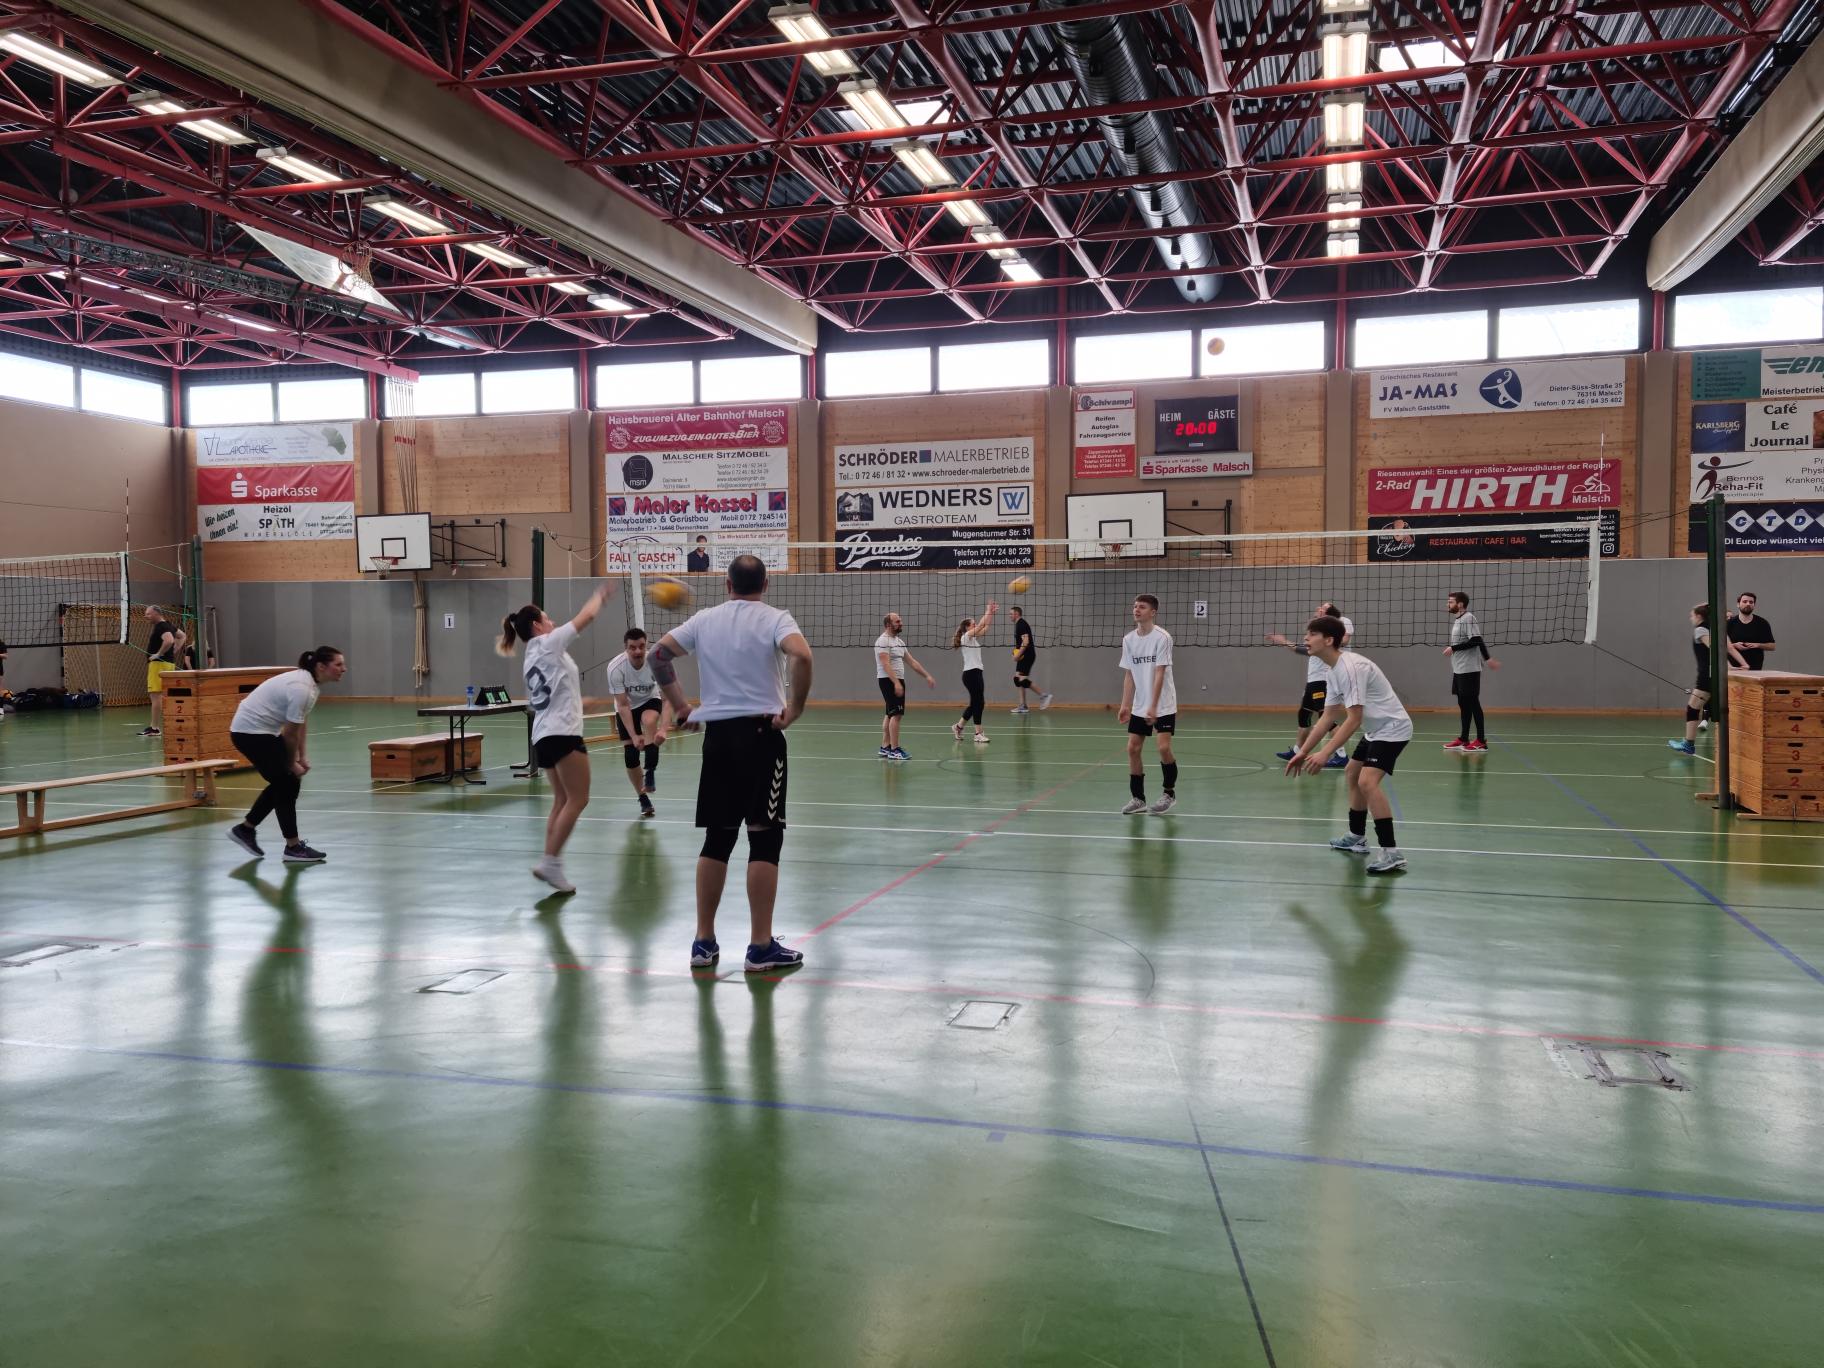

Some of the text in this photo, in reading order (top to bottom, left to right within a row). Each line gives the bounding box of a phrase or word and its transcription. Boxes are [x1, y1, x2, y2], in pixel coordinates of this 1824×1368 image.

[1379, 382, 1458, 400] JA-MAS
[1764, 402, 1798, 415] Café
[608, 408, 785, 425] Hausbrauerei Alter Bahnhof Malsch
[1160, 408, 1236, 422] HEIM GÄSTE
[1696, 420, 1740, 430] KARLSBERG
[1772, 420, 1789, 430] Le
[1750, 435, 1809, 447] Journal
[838, 447, 1030, 467] SCHRÖDER MALERBETRIEB
[912, 466, 1030, 477] www.schroeder-malerbetrieb.de
[1155, 462, 1250, 475] Sparkasse Malsch
[1475, 466, 1505, 475] größten
[1507, 463, 1564, 473] Zweiradhäuser
[1583, 462, 1611, 471] Region
[630, 478, 647, 486] msm
[1714, 482, 1763, 491] Reha-Fit
[255, 484, 318, 500] Sparkasse
[1375, 474, 1568, 510] 2-Rad HIRTH
[633, 492, 758, 515] Maler Kassel
[879, 488, 992, 508] WEDNERS
[1572, 494, 1610, 504] Malsch
[263, 505, 291, 513] Heizöl
[670, 515, 709, 523] Gerüstbau
[894, 514, 977, 526] GASTROTEAM
[952, 530, 1007, 539] Muggensturmer
[1430, 537, 1478, 546] RESTAURANT
[1736, 538, 1767, 546] Europe
[1770, 536, 1807, 545] wünscht
[638, 553, 676, 562] GASCH
[958, 558, 1031, 567] paules-fahrschule.de
[1197, 606, 1204, 616] 2
[1792, 697, 1801, 708] 5
[1791, 724, 1800, 733] 4
[1792, 750, 1800, 761] 3
[1791, 776, 1799, 787] 2
